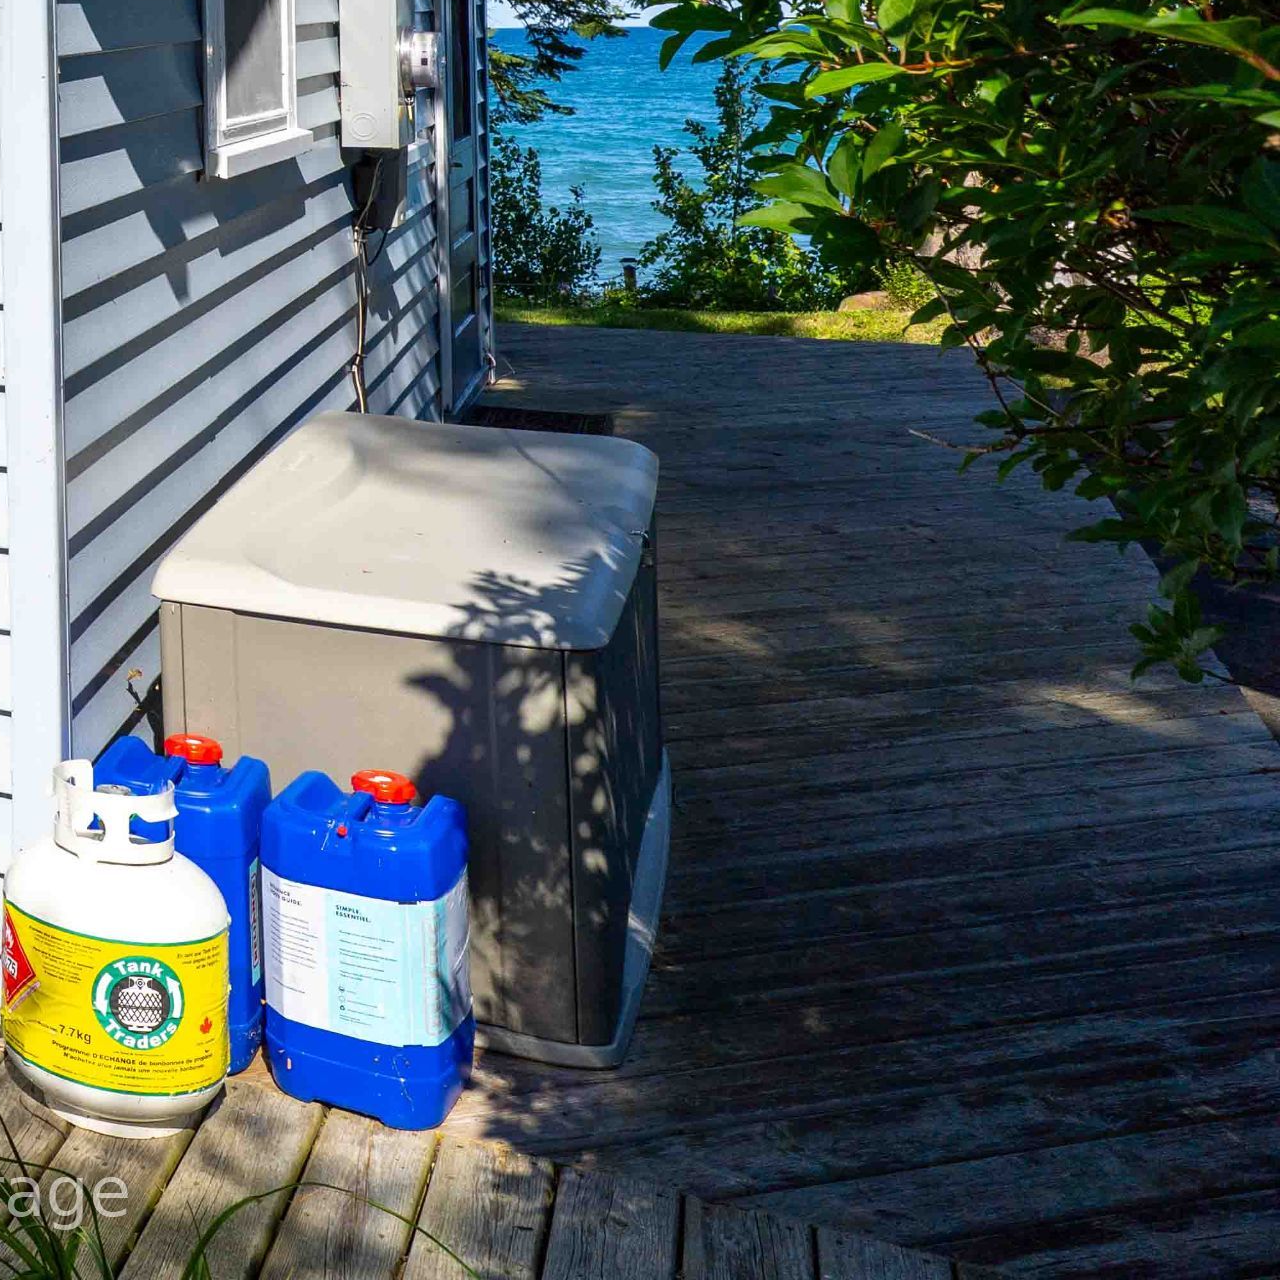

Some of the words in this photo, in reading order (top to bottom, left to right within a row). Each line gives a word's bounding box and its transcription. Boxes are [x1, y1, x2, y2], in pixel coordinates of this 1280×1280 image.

[335, 904, 361, 915] SIMPLE.
[113, 960, 164, 978] Tank
[59, 1024, 91, 1045] 7.7kg
[105, 1018, 178, 1049] Traders
[51, 1039, 90, 1057] Programme
[113, 1064, 136, 1072] jamais
